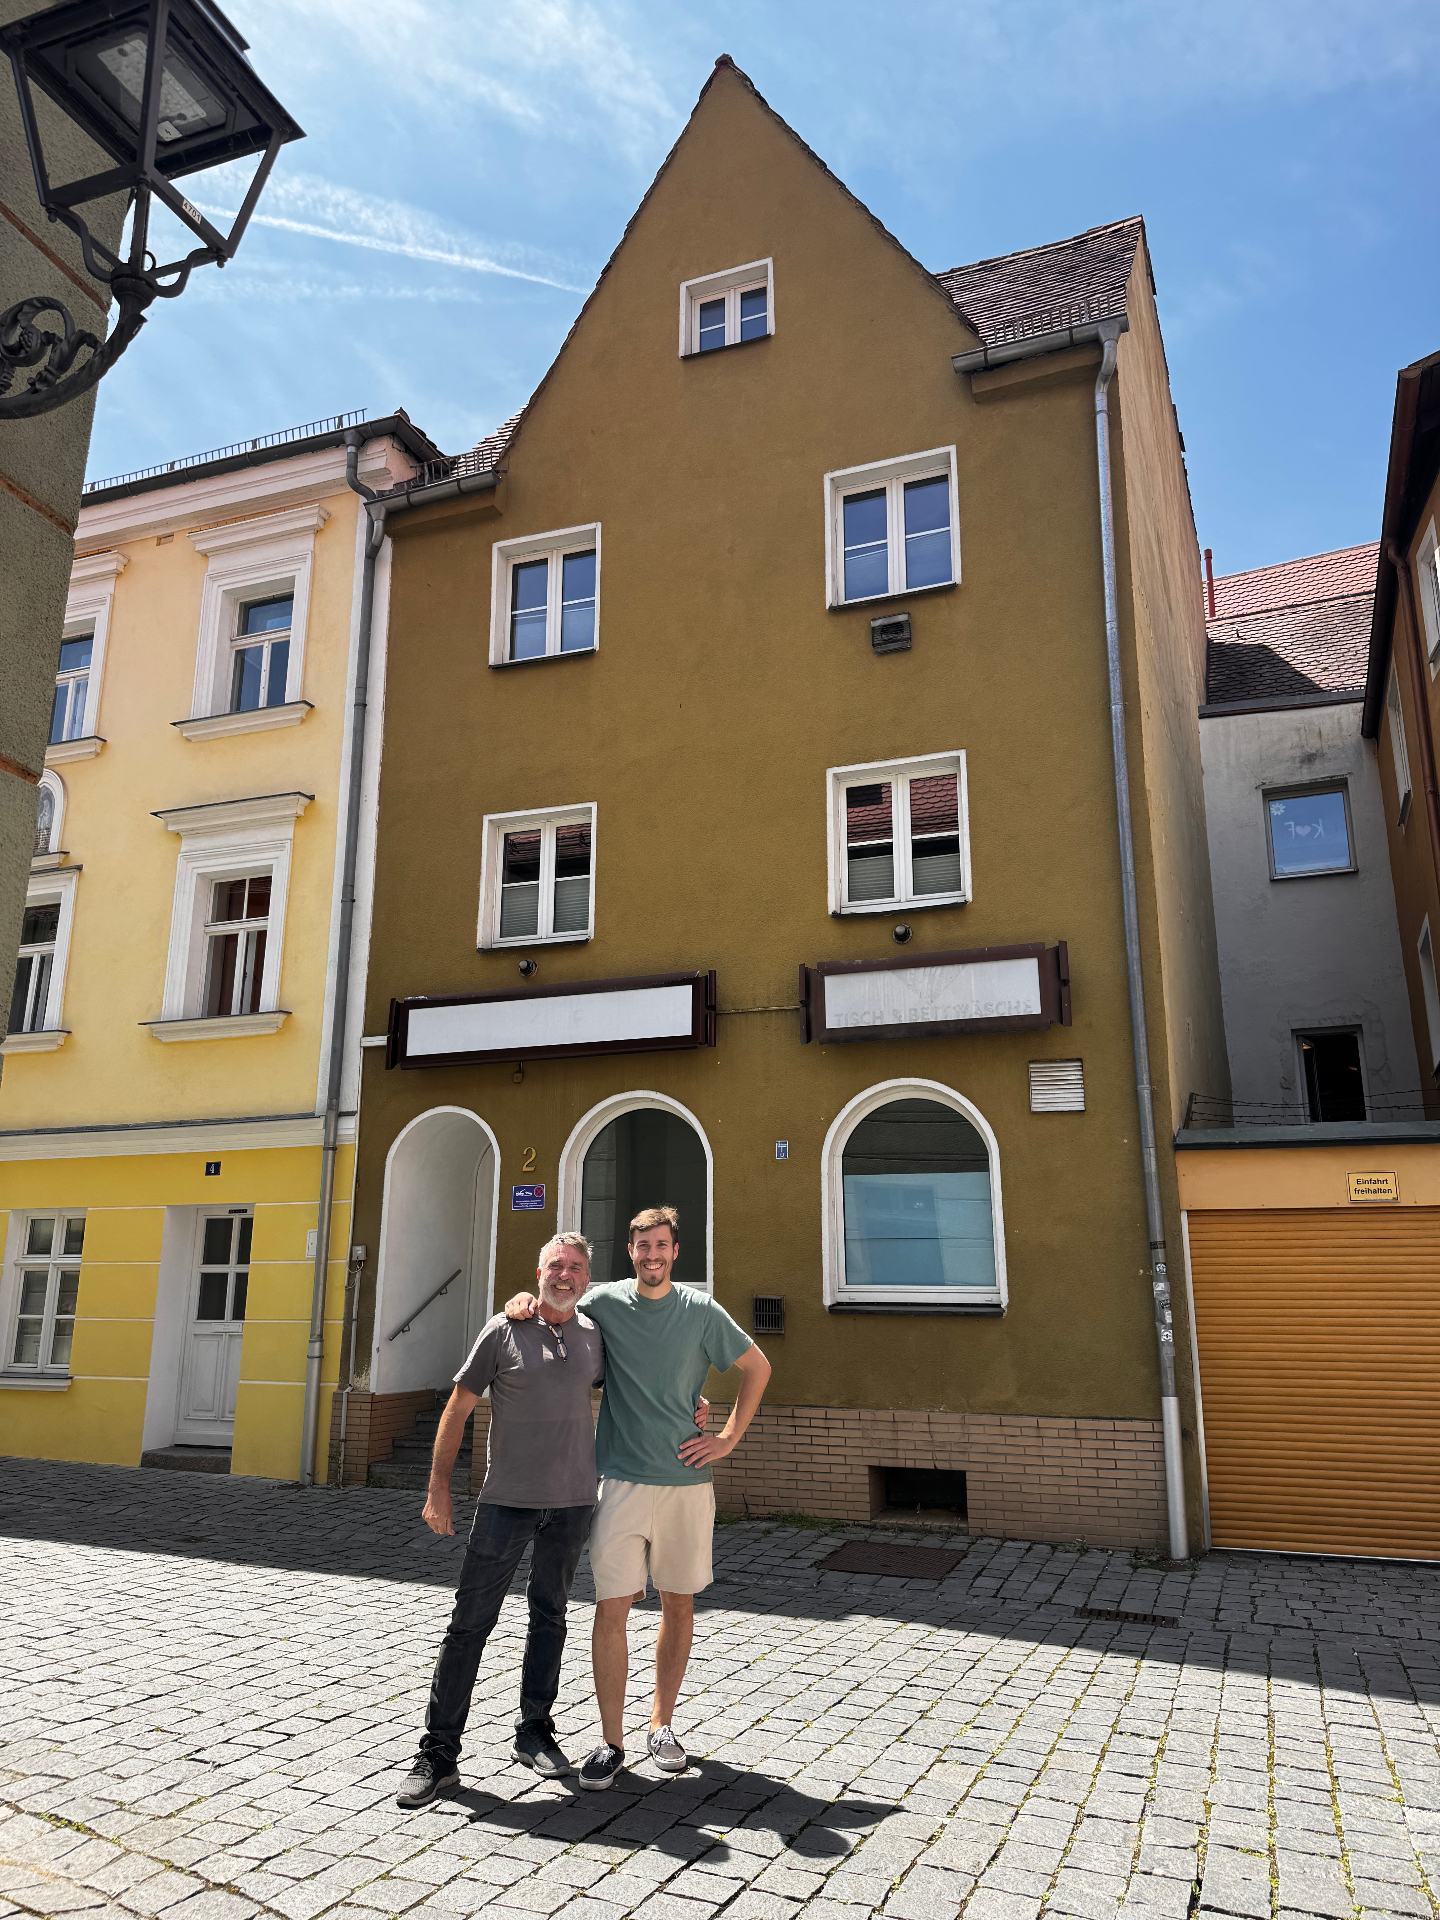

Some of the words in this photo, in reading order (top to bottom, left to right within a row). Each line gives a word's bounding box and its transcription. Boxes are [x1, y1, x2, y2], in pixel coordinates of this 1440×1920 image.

[183, 202, 201, 222] 4701
[834, 1010, 885, 1027] TISCH
[522, 1146, 537, 1172] 2
[209, 1163, 215, 1174] 4
[1353, 1187, 1393, 1195] freihalten
